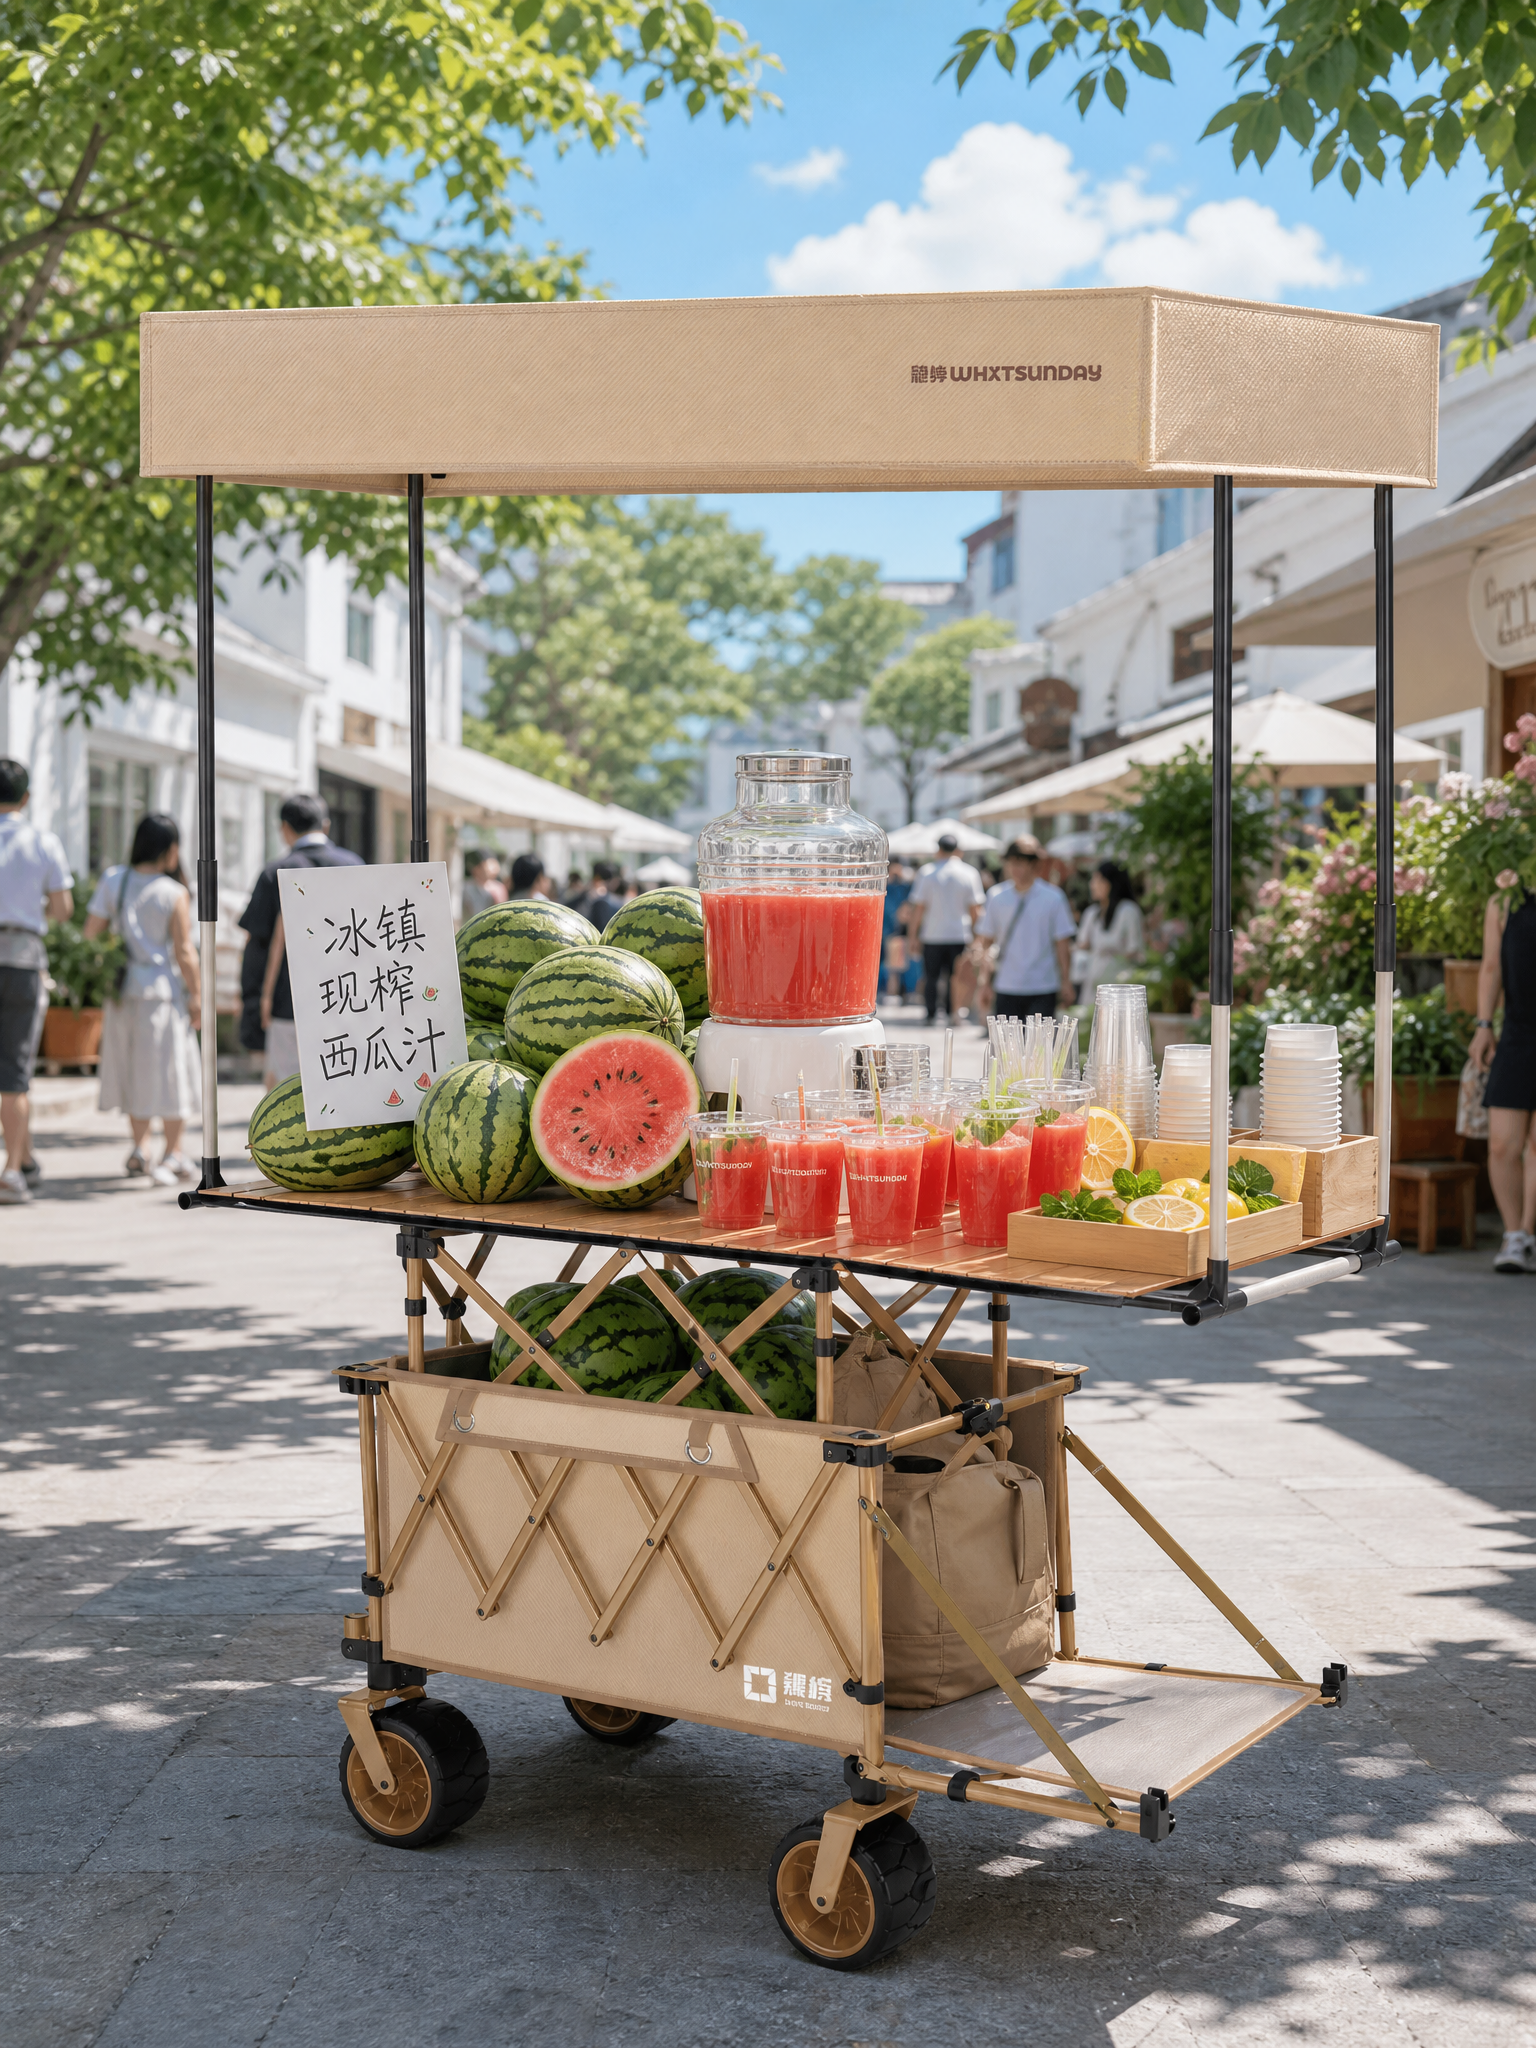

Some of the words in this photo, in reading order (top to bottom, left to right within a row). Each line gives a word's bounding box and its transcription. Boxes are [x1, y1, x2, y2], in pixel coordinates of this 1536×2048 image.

[323, 898, 426, 957] 冰镇
[319, 960, 415, 1016] 现榨
[319, 1018, 446, 1081] 西瓜汁
